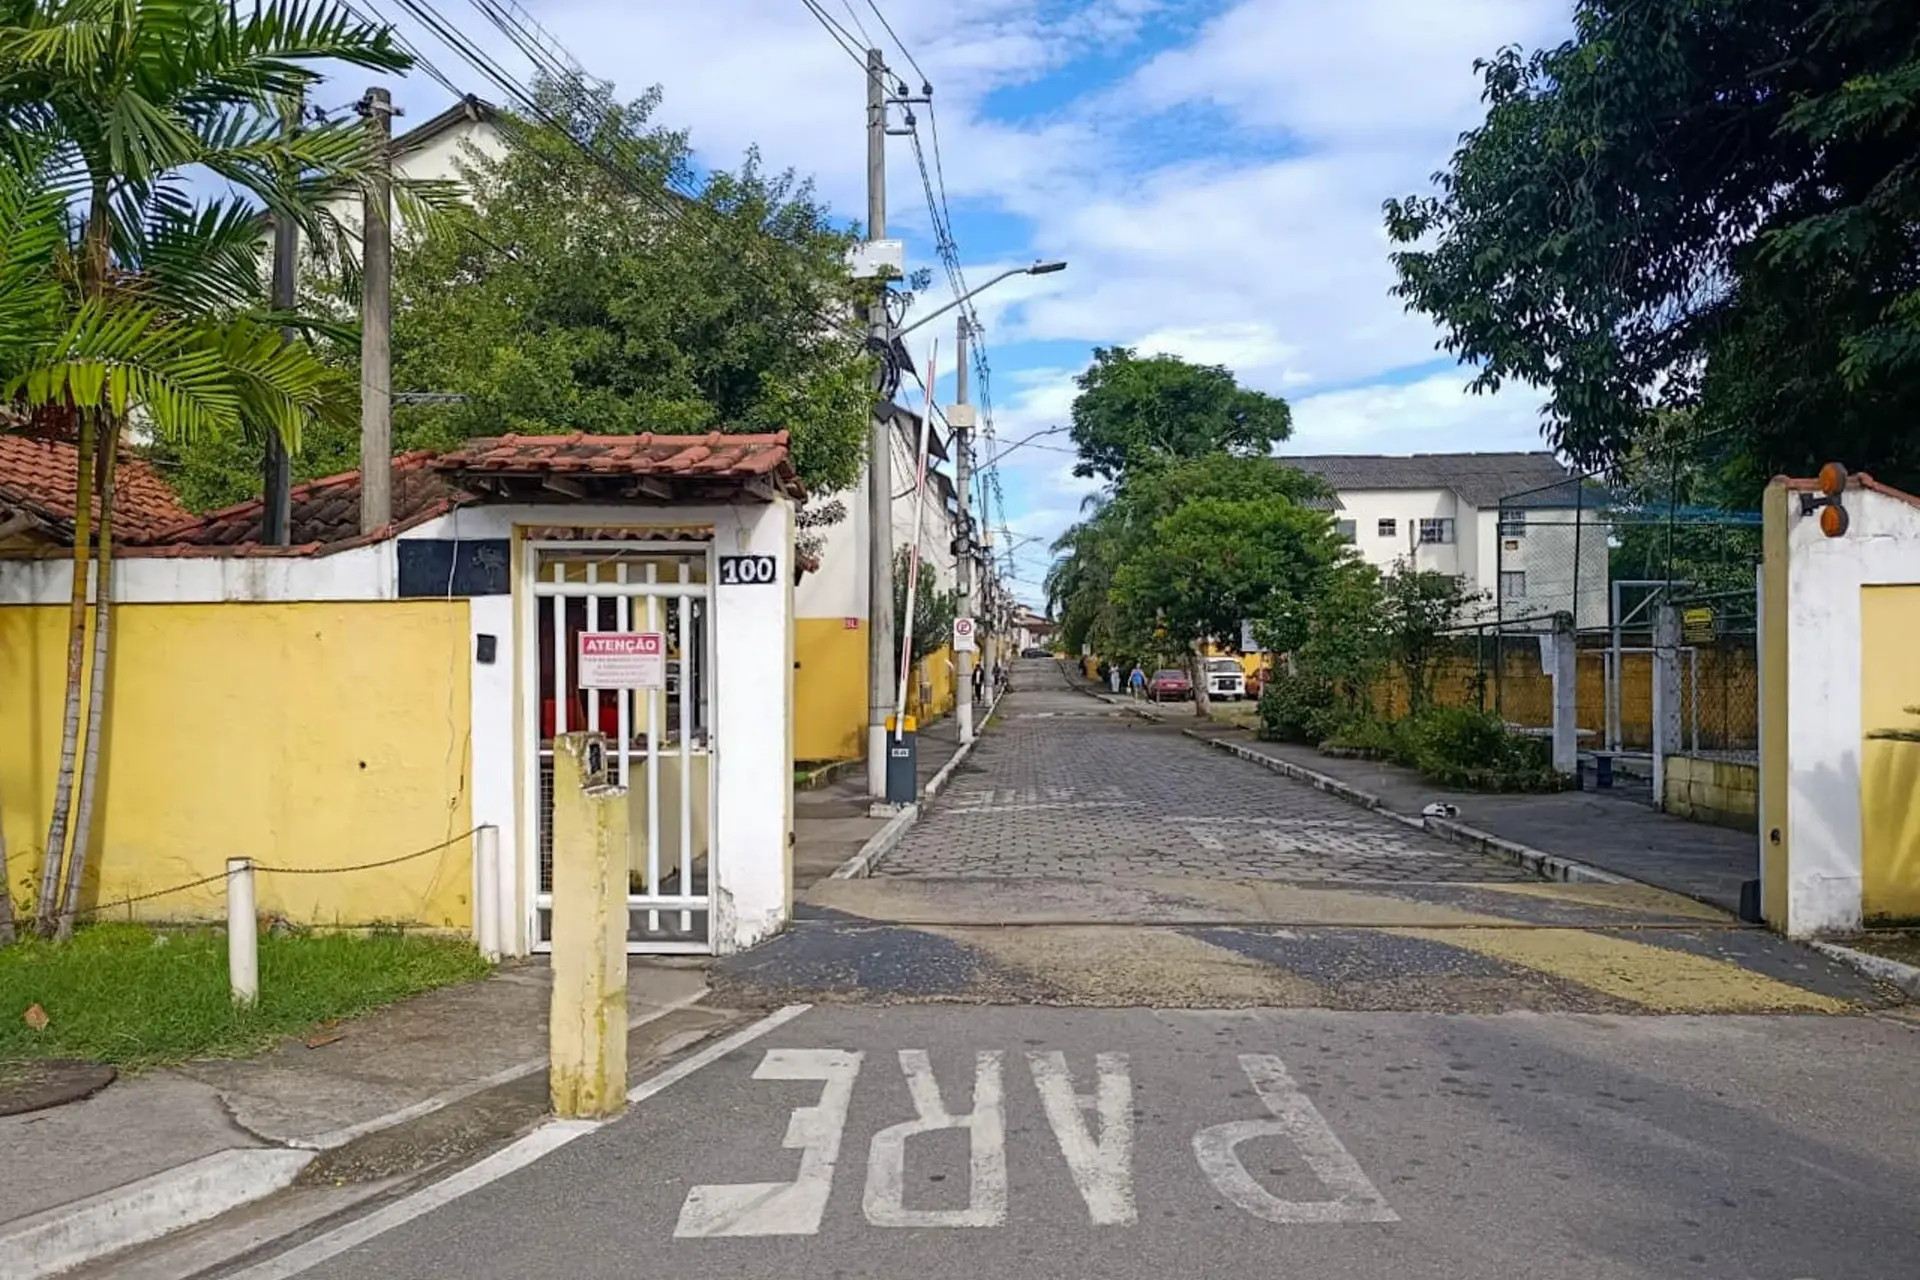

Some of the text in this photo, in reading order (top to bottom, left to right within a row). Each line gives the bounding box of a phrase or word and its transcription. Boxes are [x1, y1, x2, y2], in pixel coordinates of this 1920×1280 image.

[722, 558, 773, 583] 100
[587, 638, 657, 653] ATENÇÃO
[673, 1048, 1401, 1238] PARE
